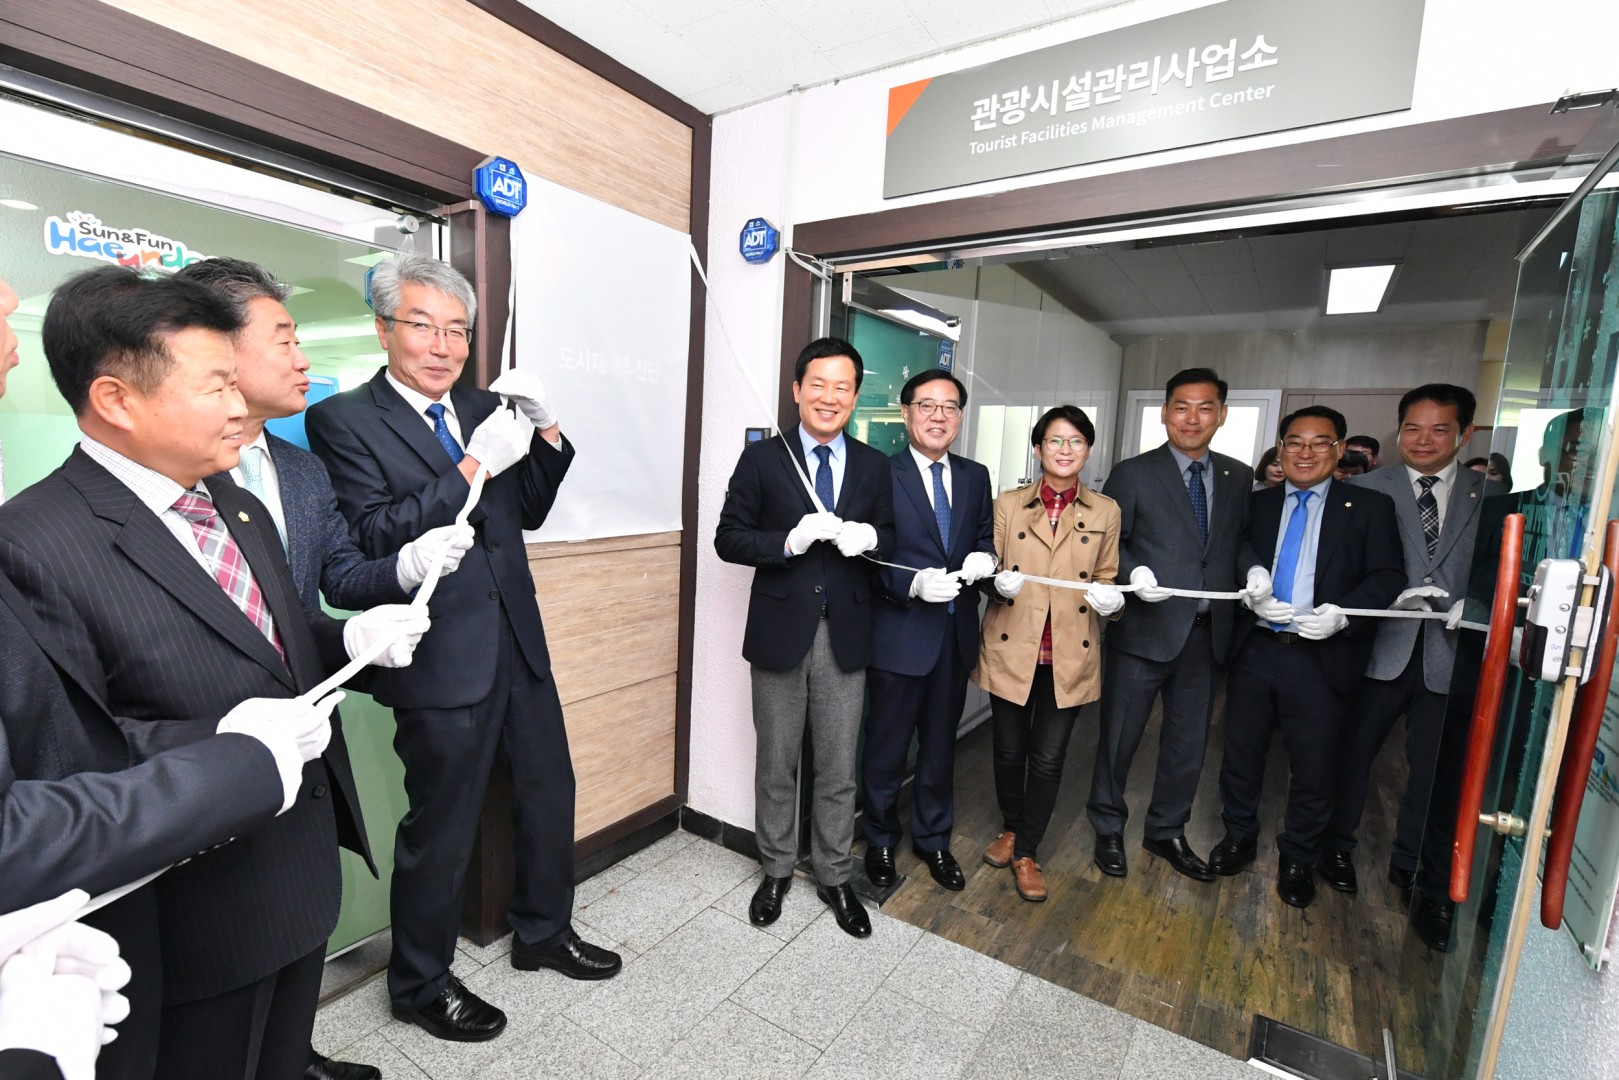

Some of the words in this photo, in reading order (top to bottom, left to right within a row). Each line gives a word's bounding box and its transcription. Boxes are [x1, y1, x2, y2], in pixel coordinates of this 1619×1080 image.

[970, 35, 1279, 132] 관광시설관리사업소
[969, 134, 1018, 155] Tourist
[1021, 122, 1088, 145] Facilities
[1092, 96, 1206, 131] Management
[1209, 84, 1276, 108] Center
[492, 176, 521, 200] ADT
[79, 221, 173, 251] Sun&Fun
[744, 230, 766, 248] ADT
[939, 352, 951, 366] ADT
